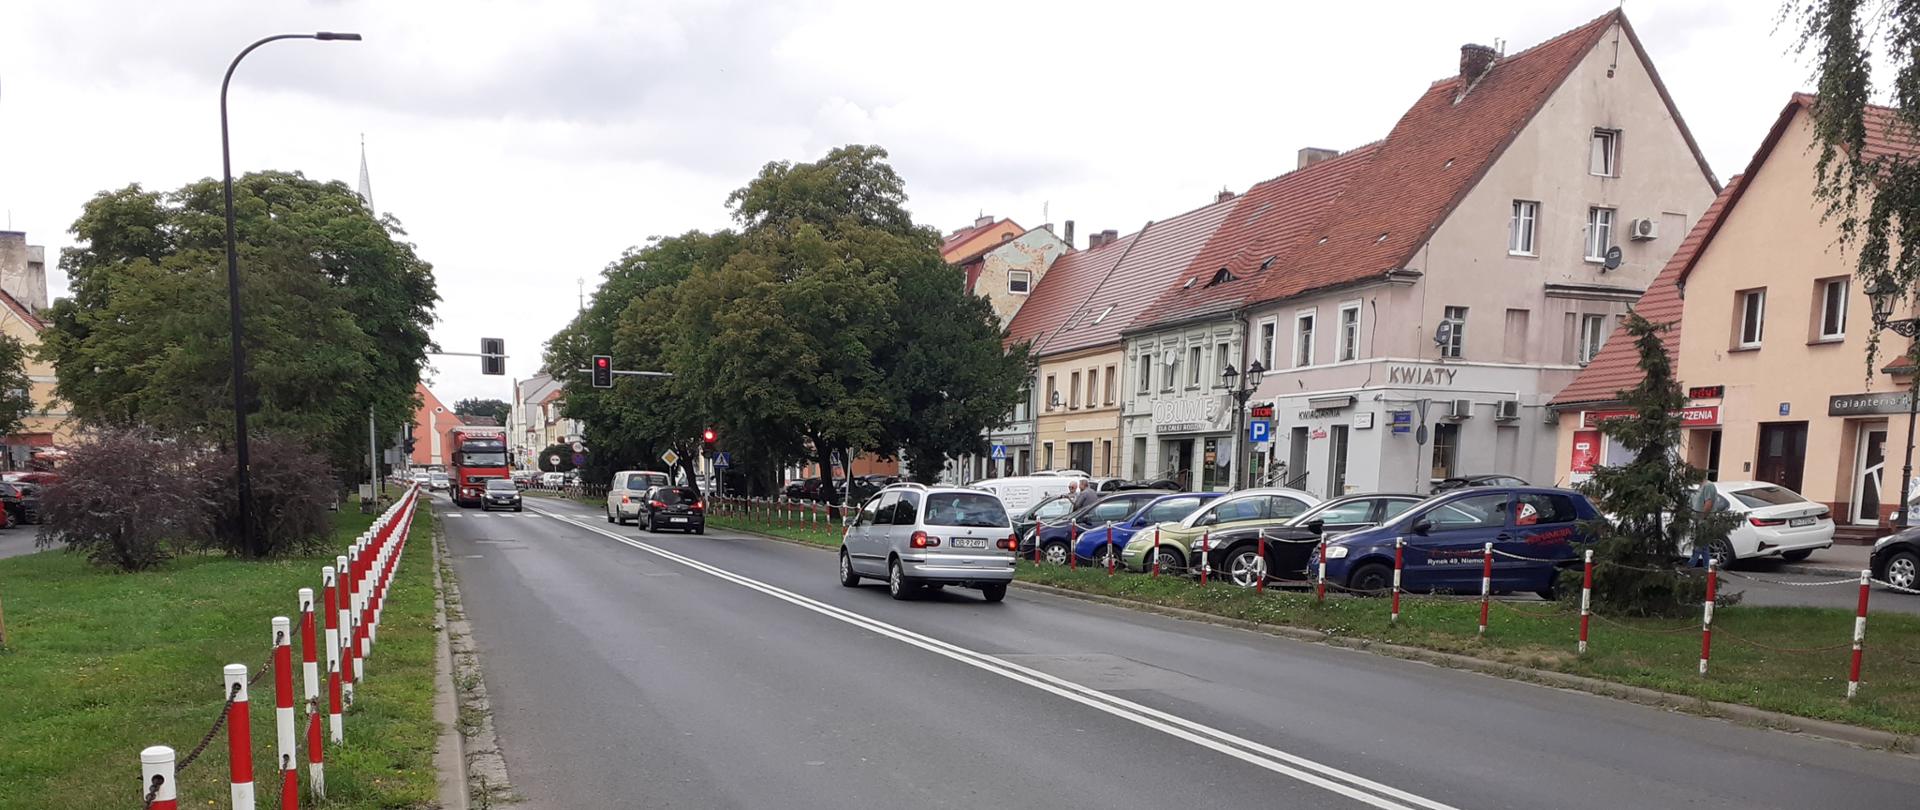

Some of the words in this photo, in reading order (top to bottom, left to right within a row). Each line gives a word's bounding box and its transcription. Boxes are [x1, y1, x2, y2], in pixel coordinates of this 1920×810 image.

[1389, 366, 1458, 386] KWIATY
[1153, 399, 1214, 424] OBUWIE
[1834, 397, 1896, 409] Galanteria
[1253, 422, 1265, 439] P
